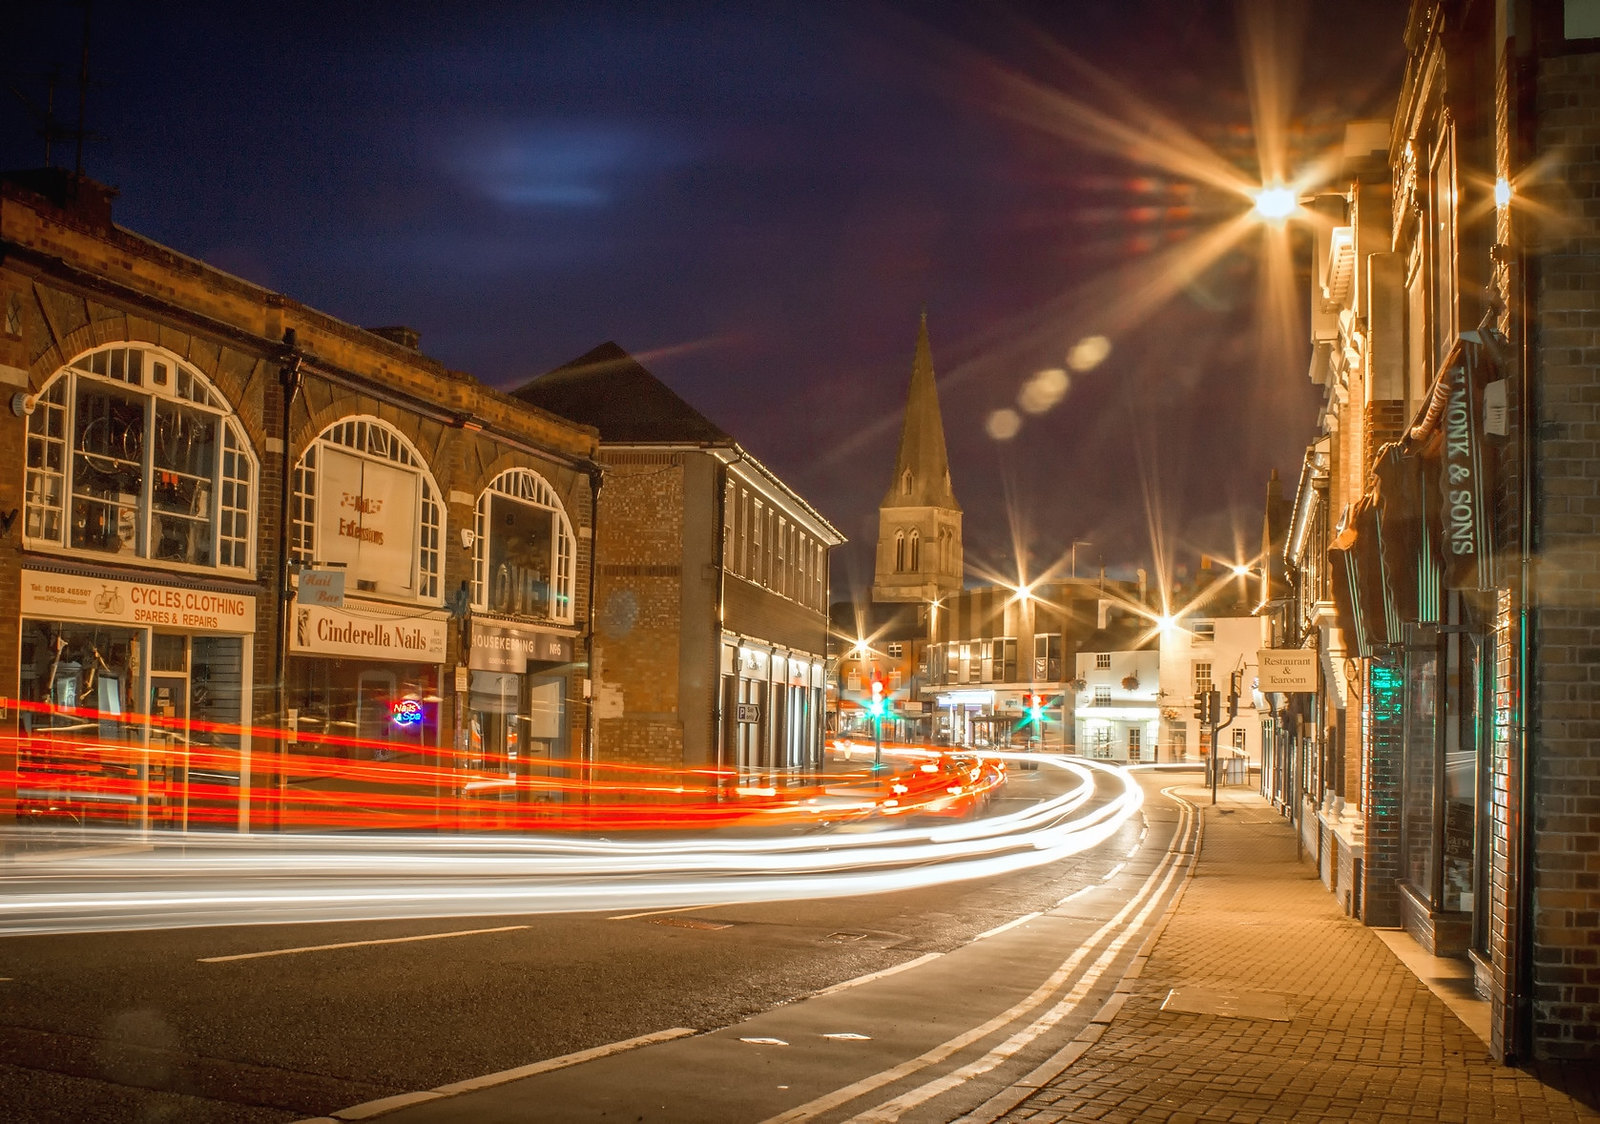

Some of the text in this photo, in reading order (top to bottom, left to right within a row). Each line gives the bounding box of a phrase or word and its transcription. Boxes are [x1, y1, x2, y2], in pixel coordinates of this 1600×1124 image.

[1448, 464, 1470, 485] &
[1450, 490, 1473, 555] SONS
[134, 609, 218, 628] SPARES & REPAIRS
[317, 617, 391, 647] Cinderella
[394, 626, 427, 650] Nails
[1264, 657, 1311, 666] Restaurant
[1283, 667, 1291, 675] &
[1270, 676, 1306, 684] Tearoom
[393, 703, 417, 713] Nails
[740, 708, 745, 719] P
[402, 711, 421, 722] Spa
